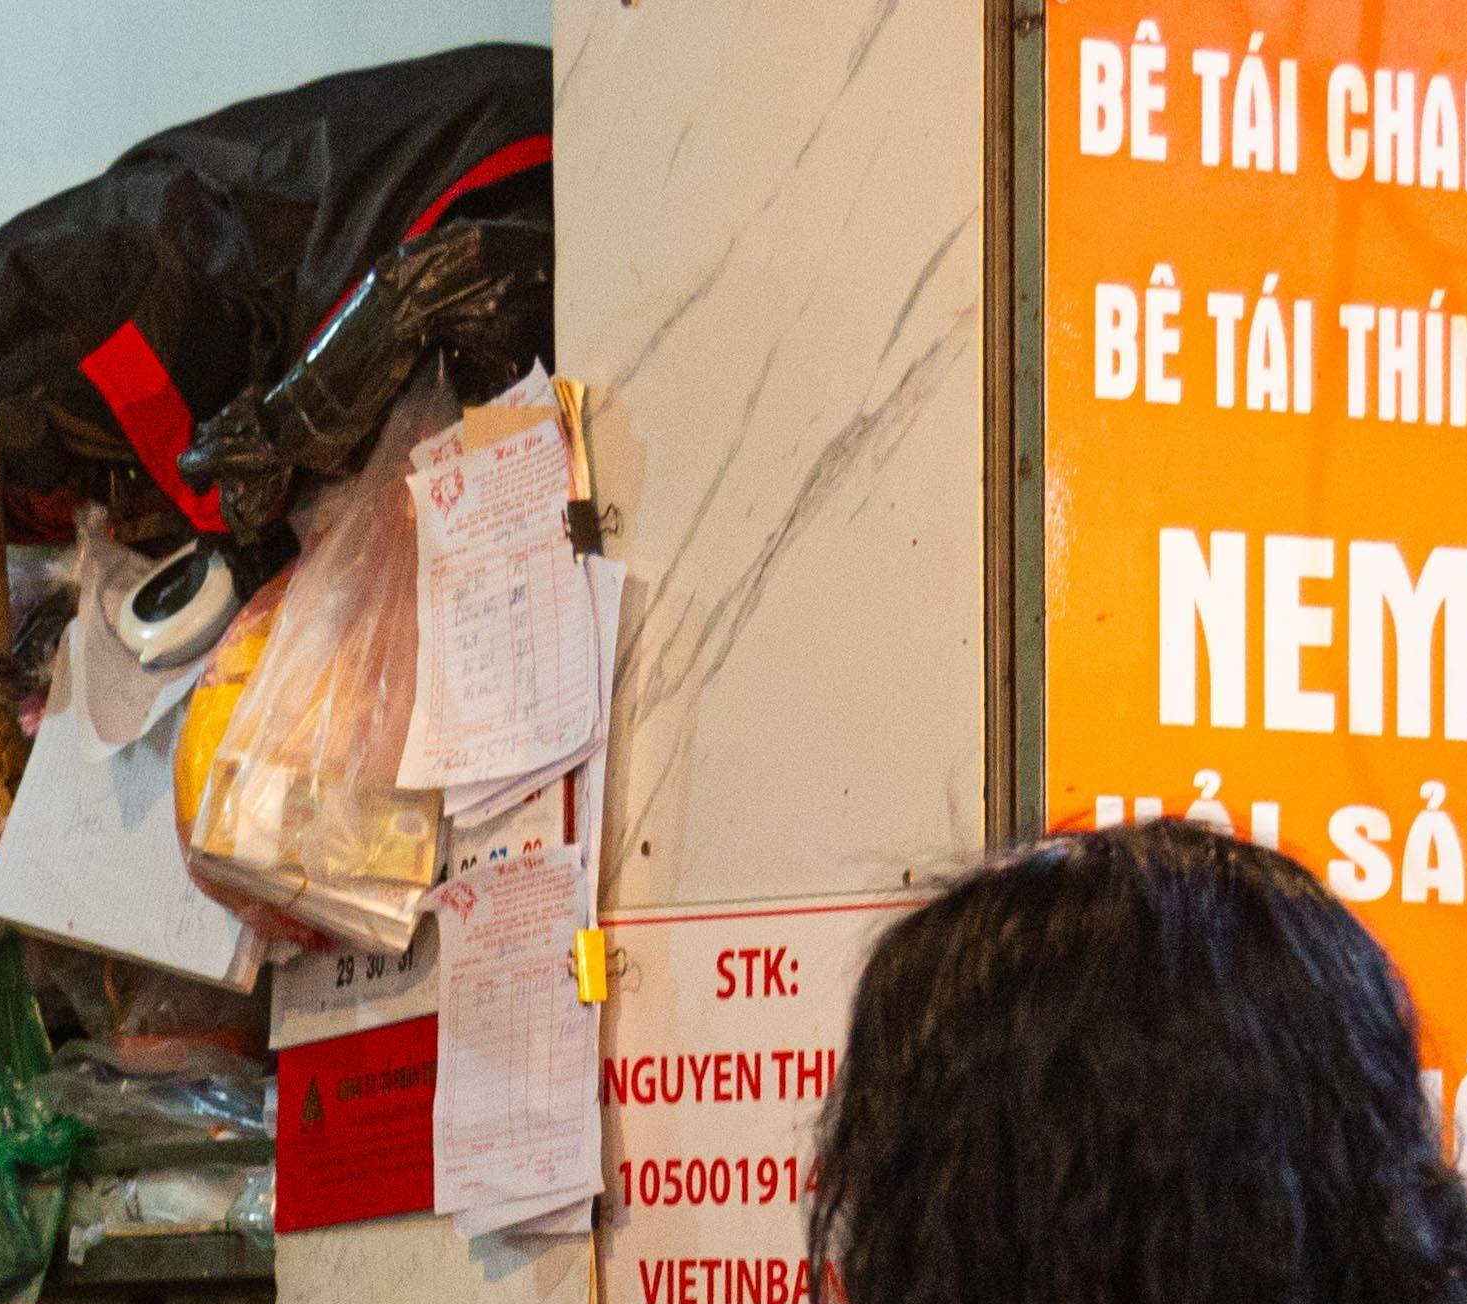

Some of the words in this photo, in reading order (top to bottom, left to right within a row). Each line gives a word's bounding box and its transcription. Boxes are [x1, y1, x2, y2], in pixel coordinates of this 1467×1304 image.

[1079, 20, 1168, 162] BÊ
[1192, 31, 1298, 174] TÁI
[1094, 264, 1182, 404] BÊ
[1206, 273, 1313, 414] TÁI
[336, 955, 355, 989] 29
[715, 946, 800, 1001] STK:
[602, 1050, 763, 1108] NGUYEN
[771, 1047, 837, 1100] THI
